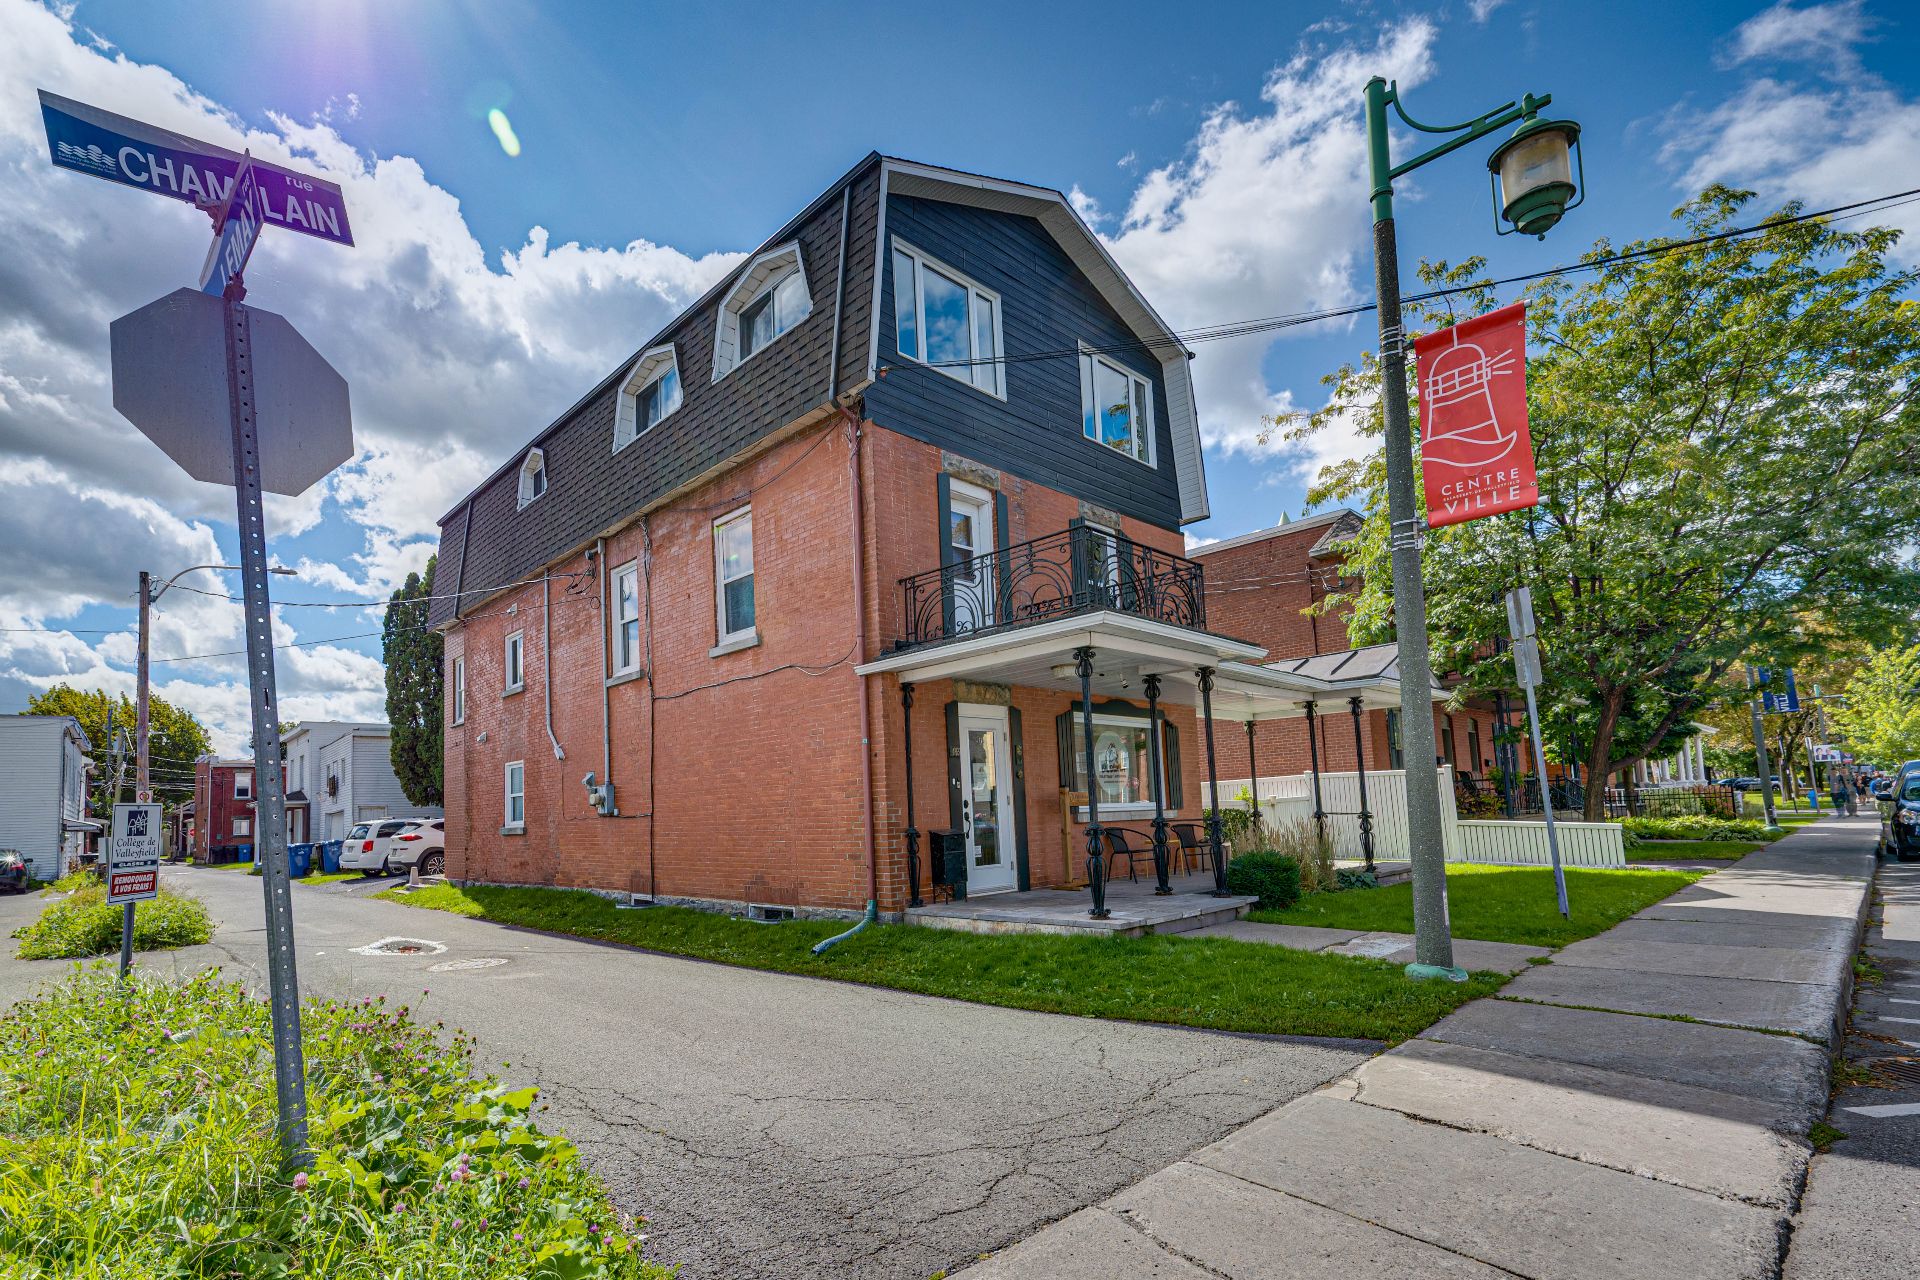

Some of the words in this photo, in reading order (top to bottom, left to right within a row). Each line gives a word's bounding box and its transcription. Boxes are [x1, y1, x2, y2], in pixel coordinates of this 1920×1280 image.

[118, 146, 341, 237] CHAMLAIN
[285, 175, 313, 192] rue
[1441, 467, 1519, 496] CENTRE
[1444, 485, 1520, 515] VILLE
[116, 838, 145, 848] Collège
[148, 837, 156, 846] de
[116, 848, 156, 858] Valleyfield
[114, 874, 154, 884] REMORQUAGE
